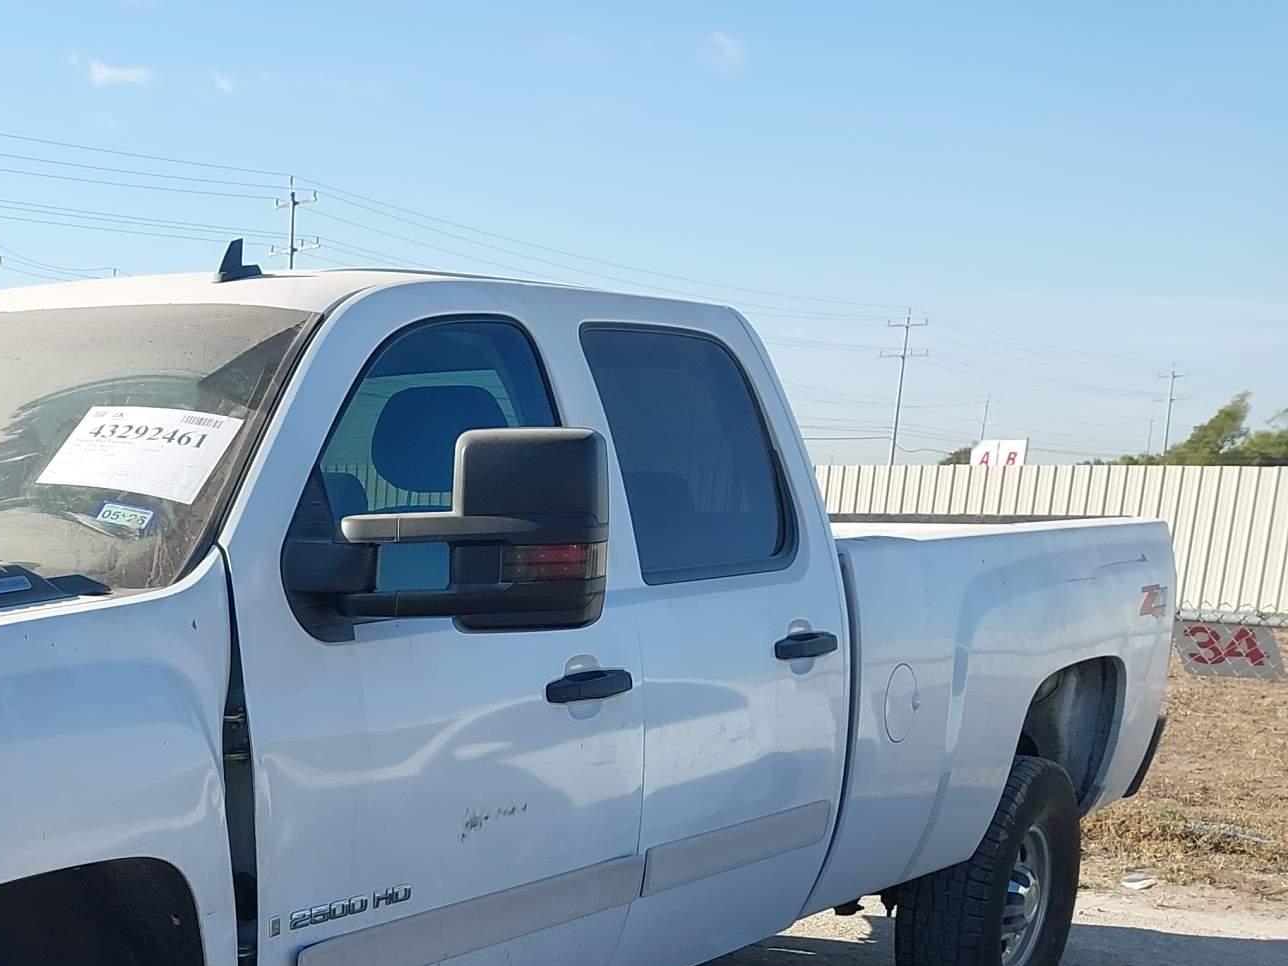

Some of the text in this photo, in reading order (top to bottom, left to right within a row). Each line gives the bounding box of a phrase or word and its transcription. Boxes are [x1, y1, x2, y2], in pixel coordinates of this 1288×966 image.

[89, 423, 208, 448] 43292461
[1183, 624, 1268, 666] 34
[289, 883, 412, 931] 2500 HD
